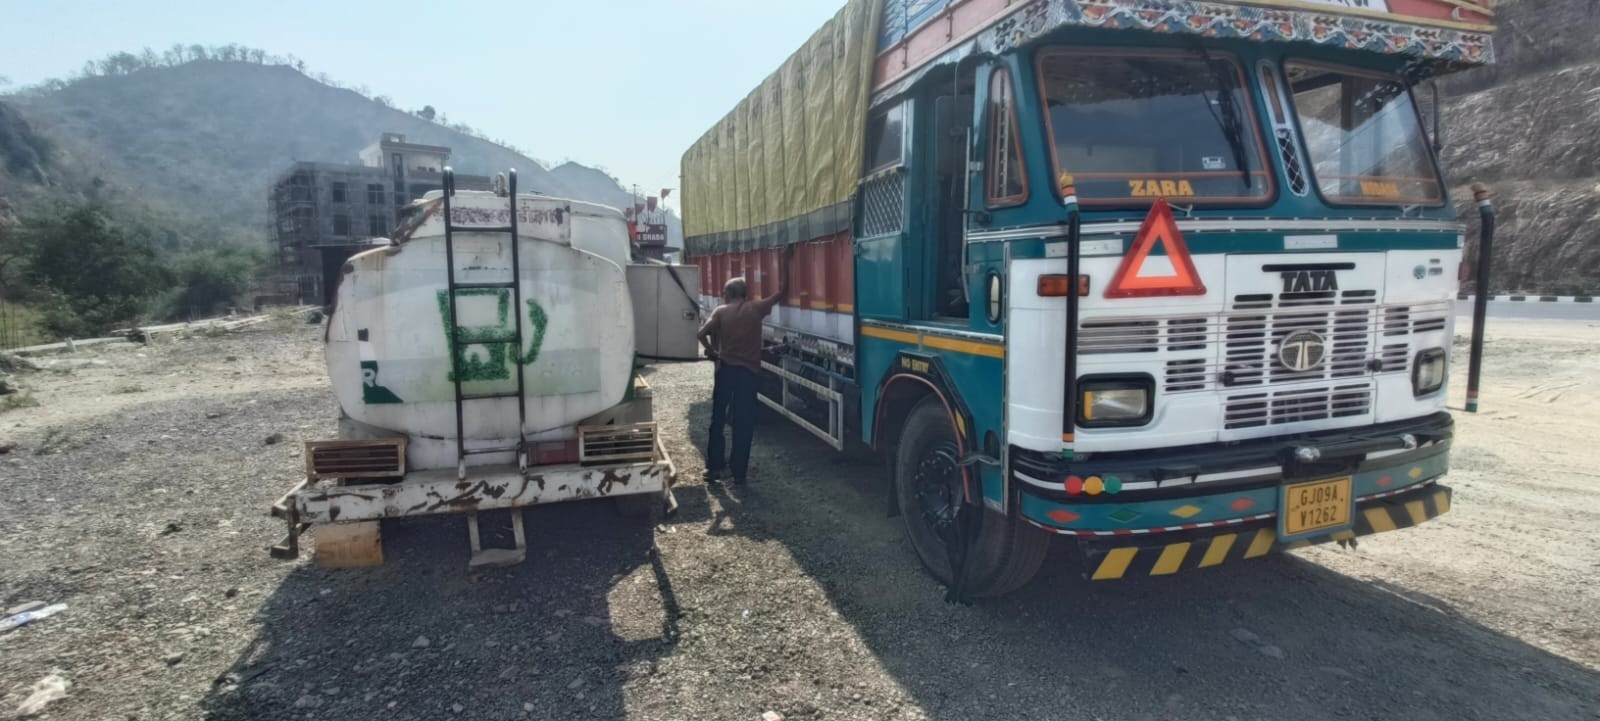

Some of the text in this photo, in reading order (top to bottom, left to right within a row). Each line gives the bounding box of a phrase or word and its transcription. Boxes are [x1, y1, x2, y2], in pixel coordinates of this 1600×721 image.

[1129, 179, 1194, 196] ZARA
[1281, 270, 1338, 292] TATA
[1301, 485, 1338, 506] GJ09A
[1301, 505, 1337, 527] V1262
